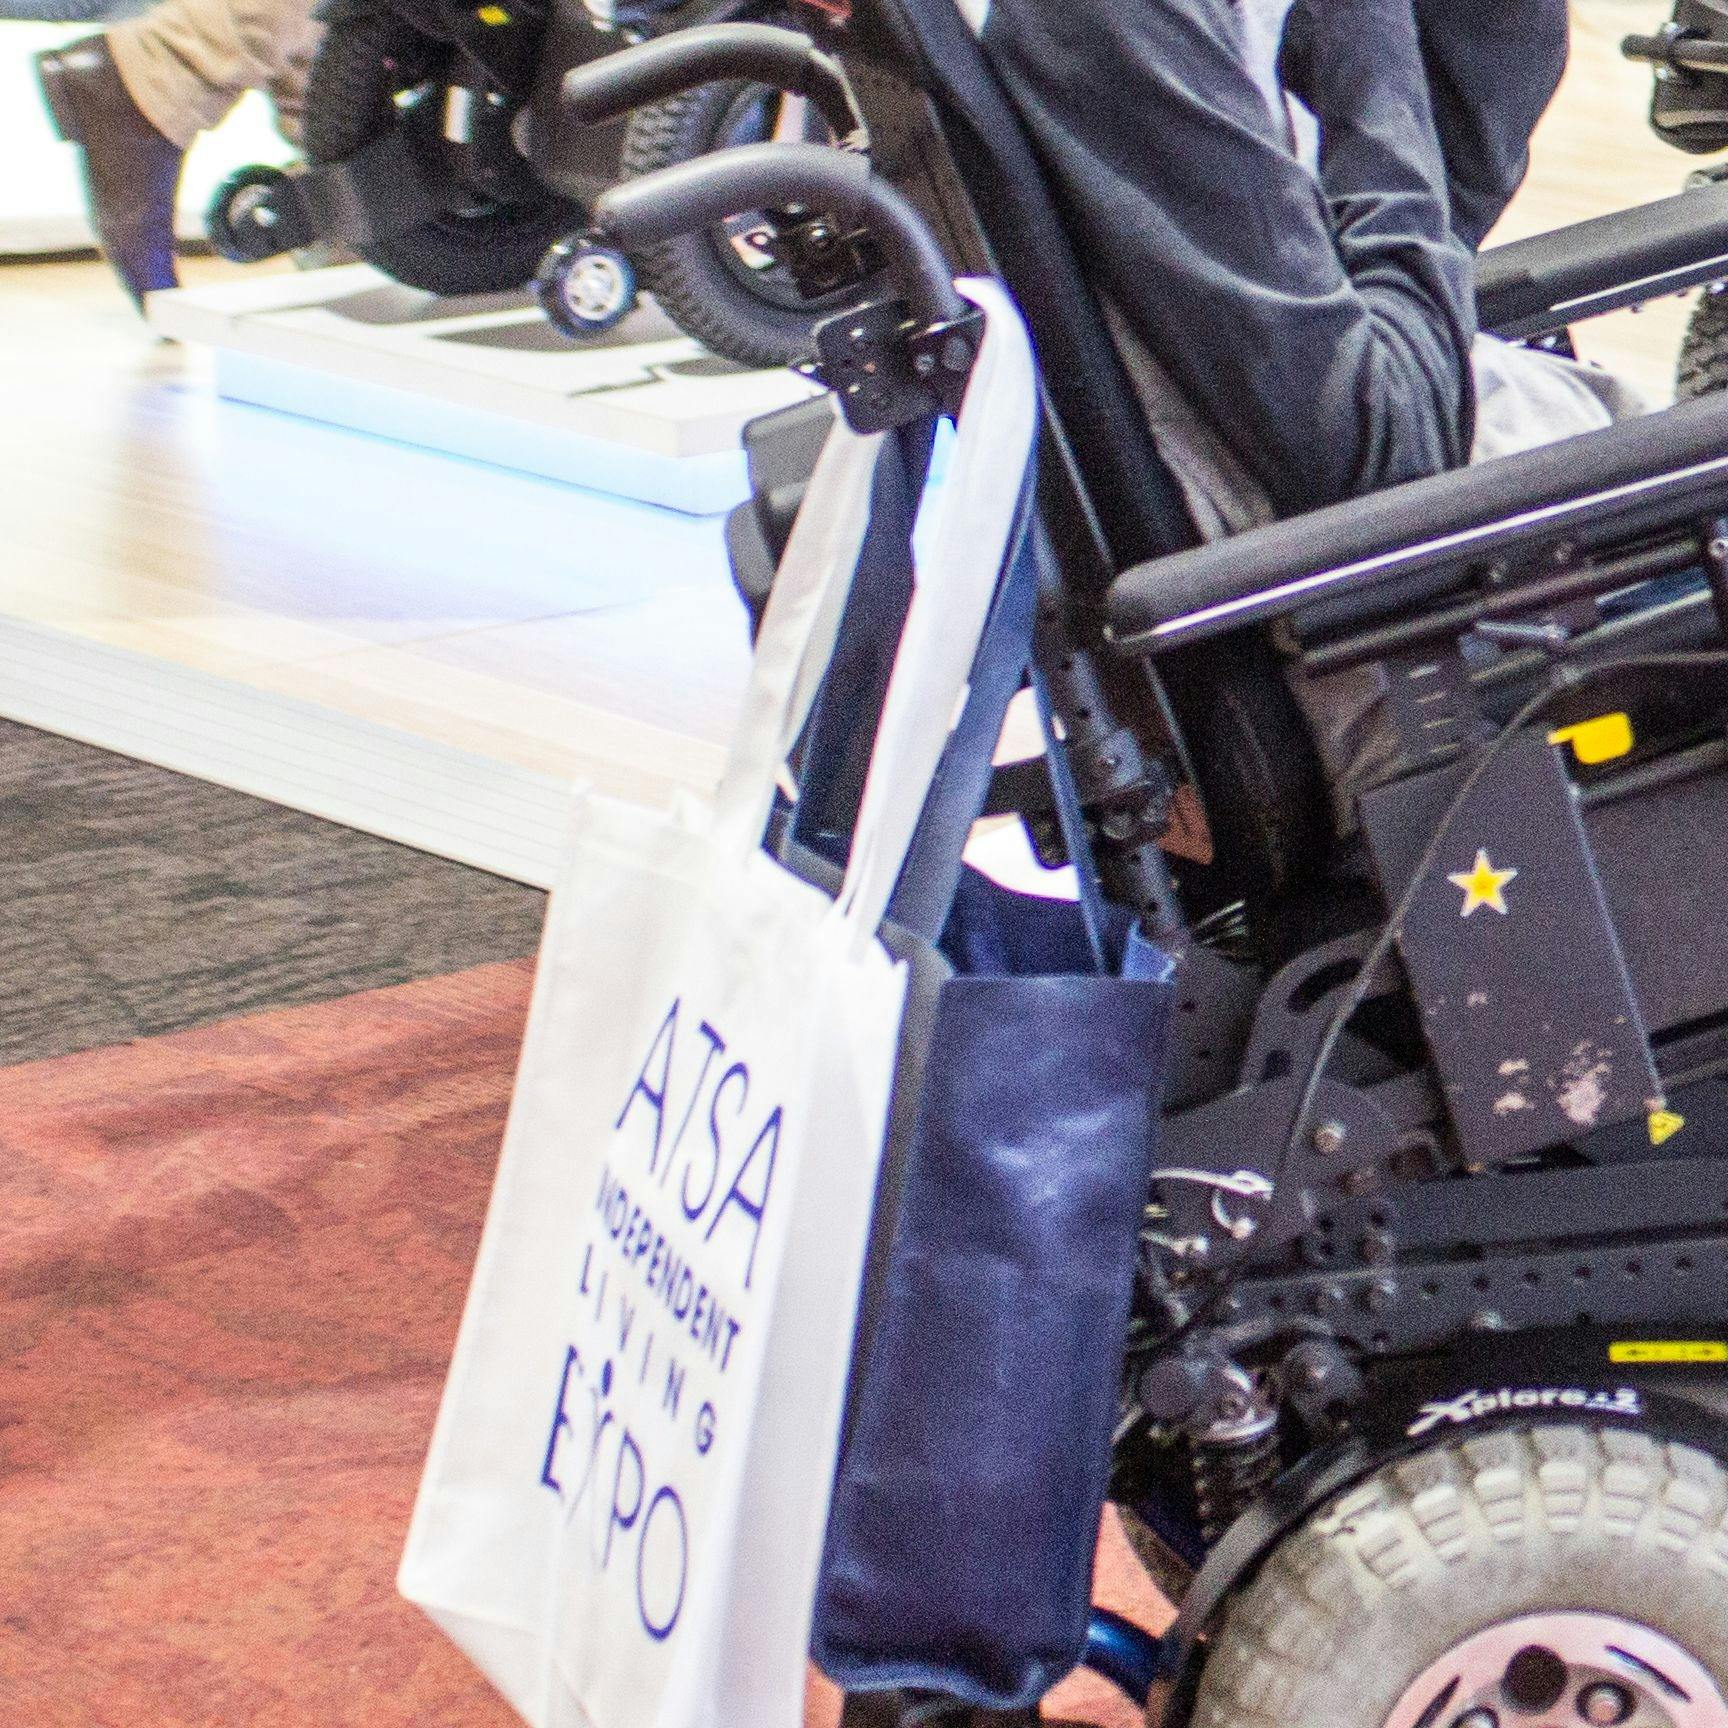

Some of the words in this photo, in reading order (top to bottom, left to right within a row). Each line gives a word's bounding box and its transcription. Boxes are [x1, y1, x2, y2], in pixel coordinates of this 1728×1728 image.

[614, 996, 783, 1291] ATSA
[540, 1344, 690, 1643] EXPO
[580, 1243, 718, 1457] LIVING
